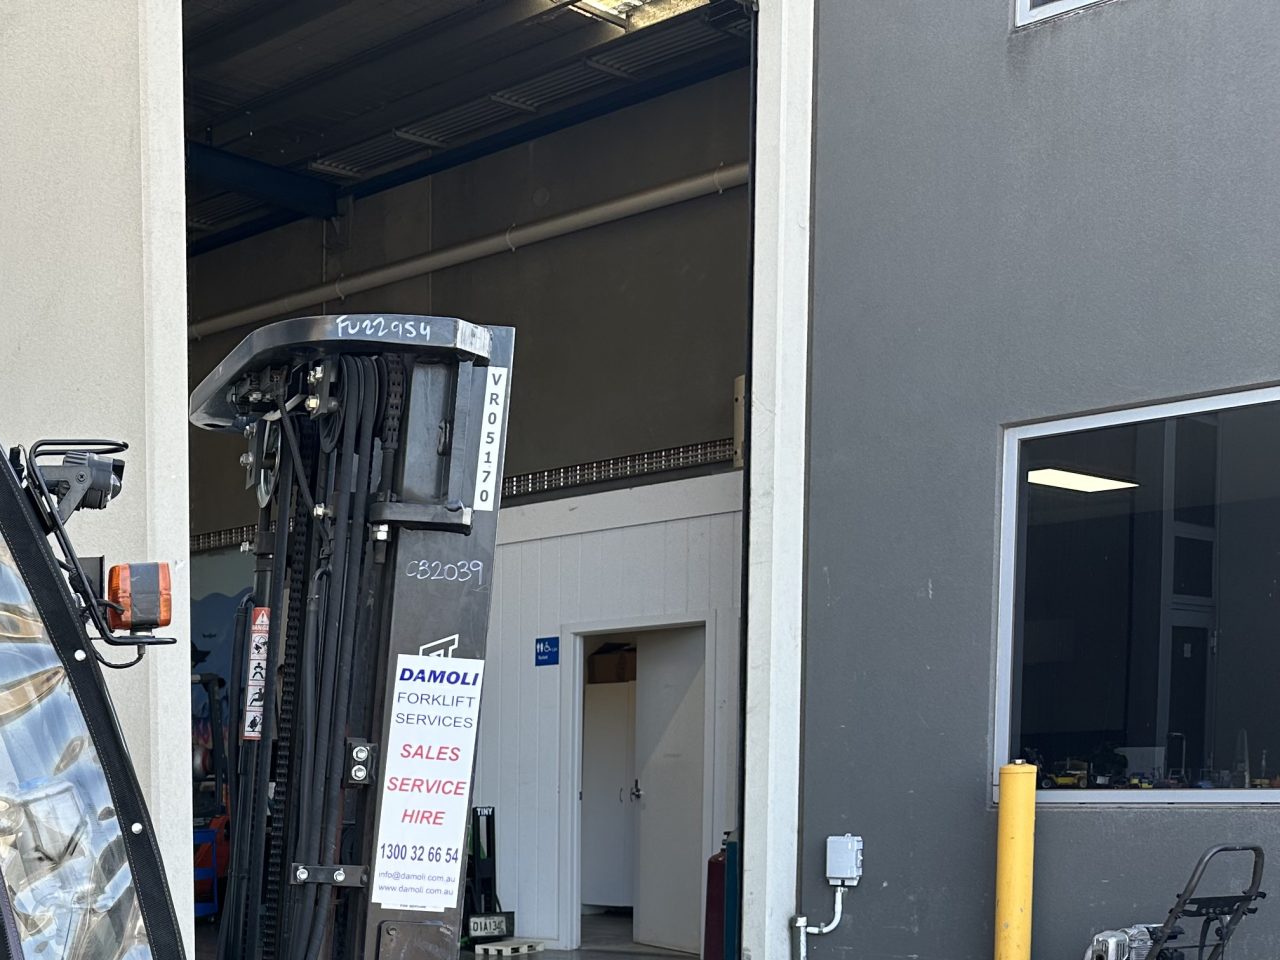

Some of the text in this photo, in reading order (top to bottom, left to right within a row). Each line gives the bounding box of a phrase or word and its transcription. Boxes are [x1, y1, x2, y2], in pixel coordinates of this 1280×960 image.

[480, 373, 502, 502] VR05170
[399, 668, 479, 686] DAMOLI
[397, 692, 476, 708] FORKLIFT
[395, 712, 473, 728] SERVICES
[400, 744, 461, 761] SALES
[387, 776, 467, 796] SERVICE
[401, 809, 446, 826] HIRE
[380, 843, 459, 863] 1300 32 66 54
